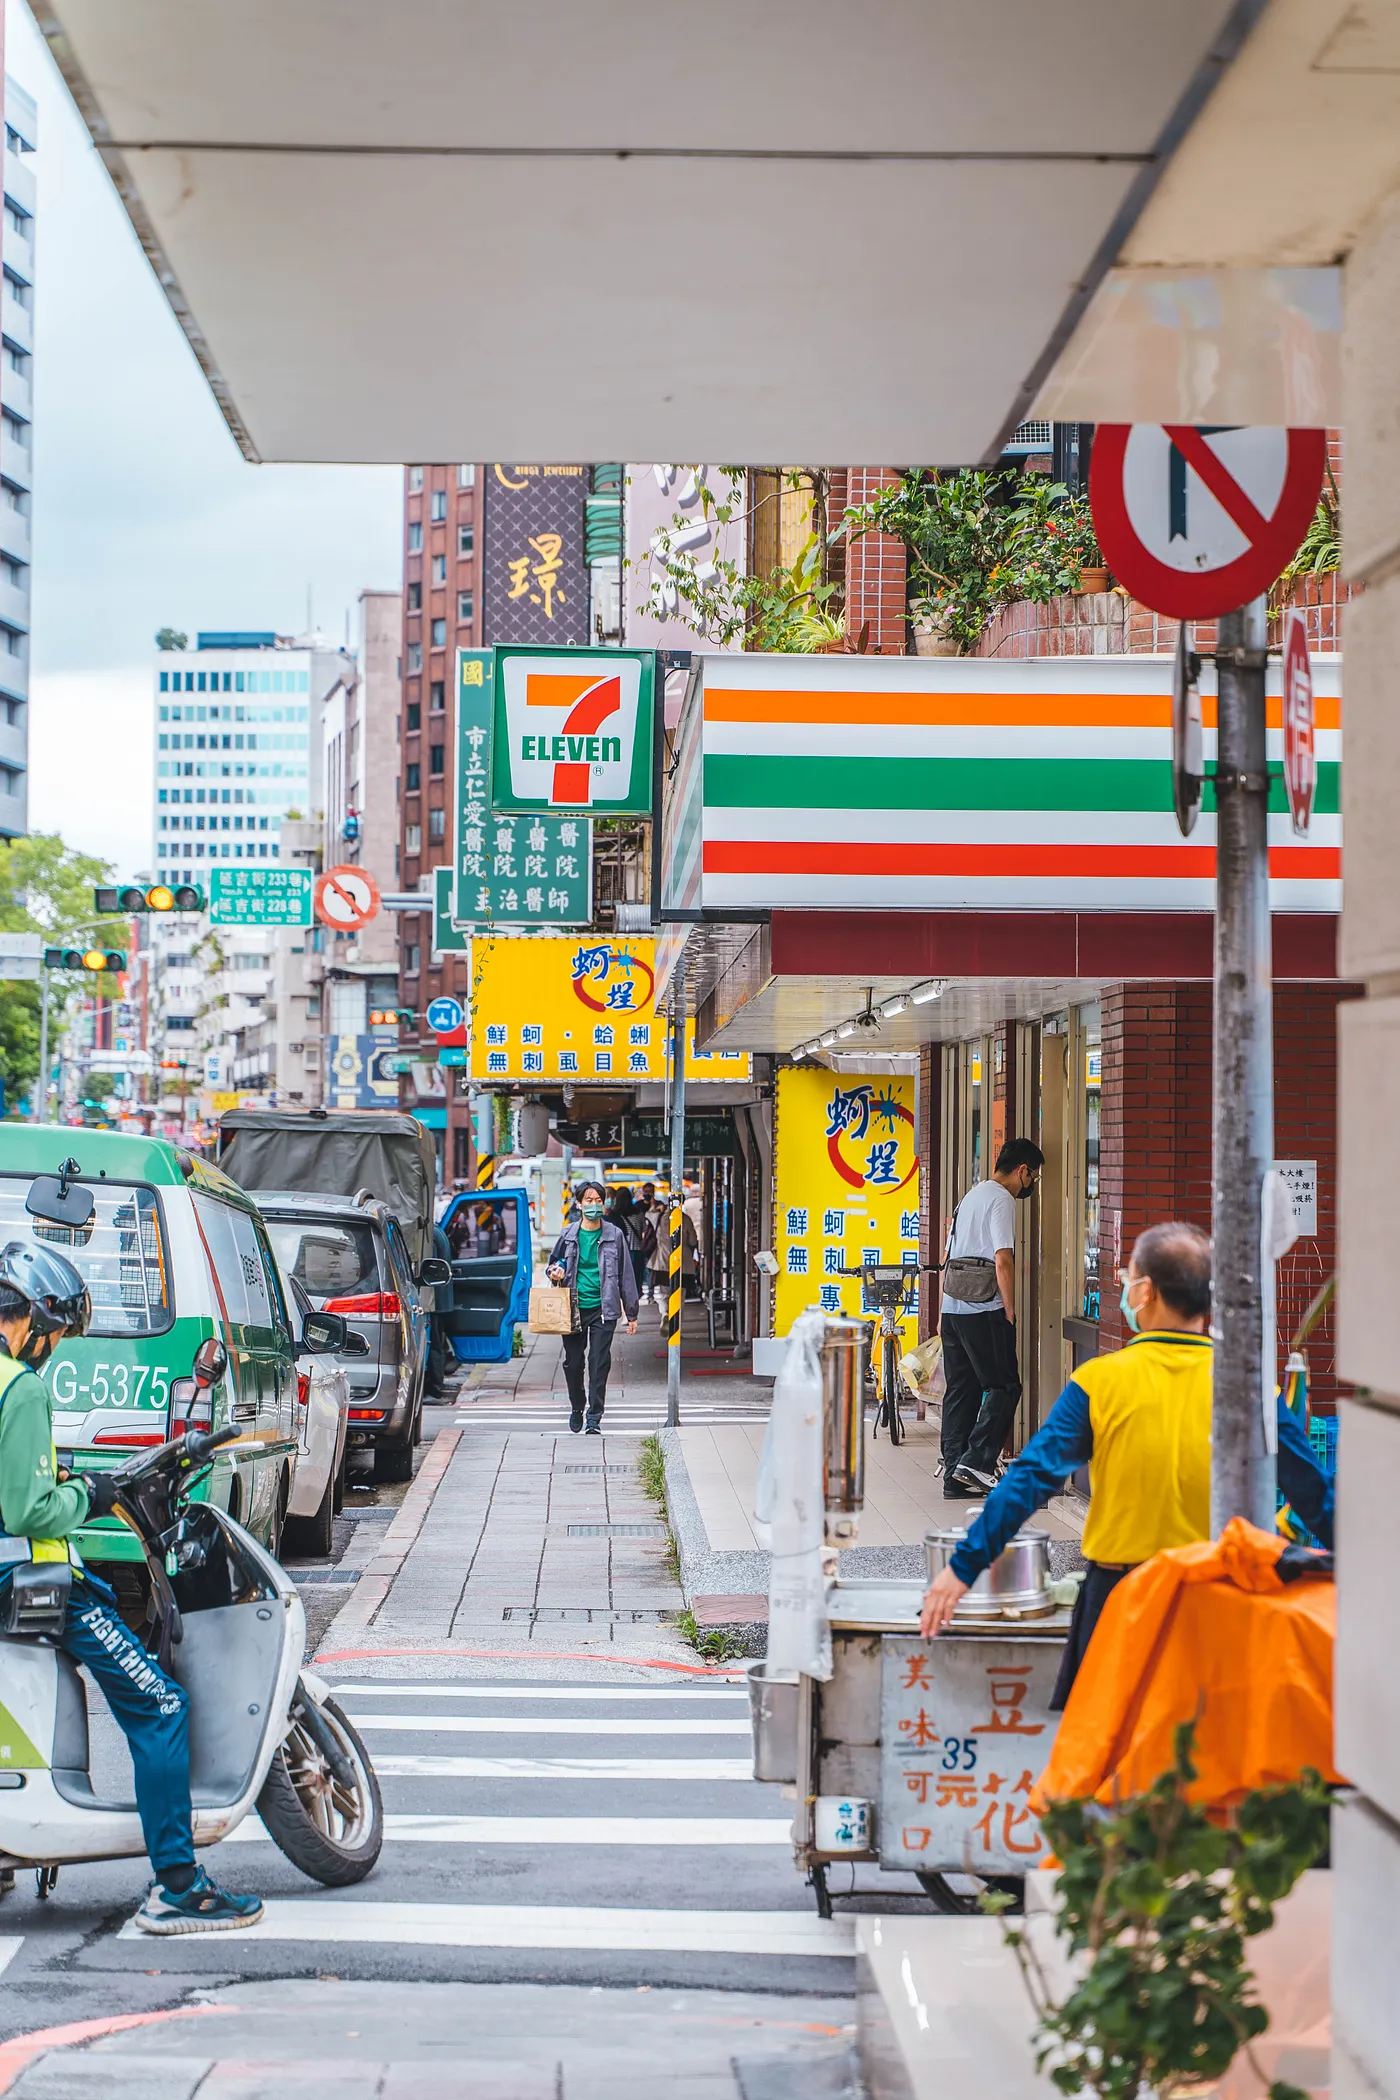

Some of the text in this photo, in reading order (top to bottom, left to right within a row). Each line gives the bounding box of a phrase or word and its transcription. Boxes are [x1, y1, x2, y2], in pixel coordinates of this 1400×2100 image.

[526, 674, 621, 803] 7
[462, 726, 488, 878] 市立仁愛醫院
[556, 821, 580, 879] 醫院
[474, 886, 570, 915] 主治醫師
[37, 1360, 169, 1409] G-5375
[942, 1737, 978, 1770] 35
[970, 1666, 1046, 1853] 豆花
[936, 1775, 978, 1808] 元
